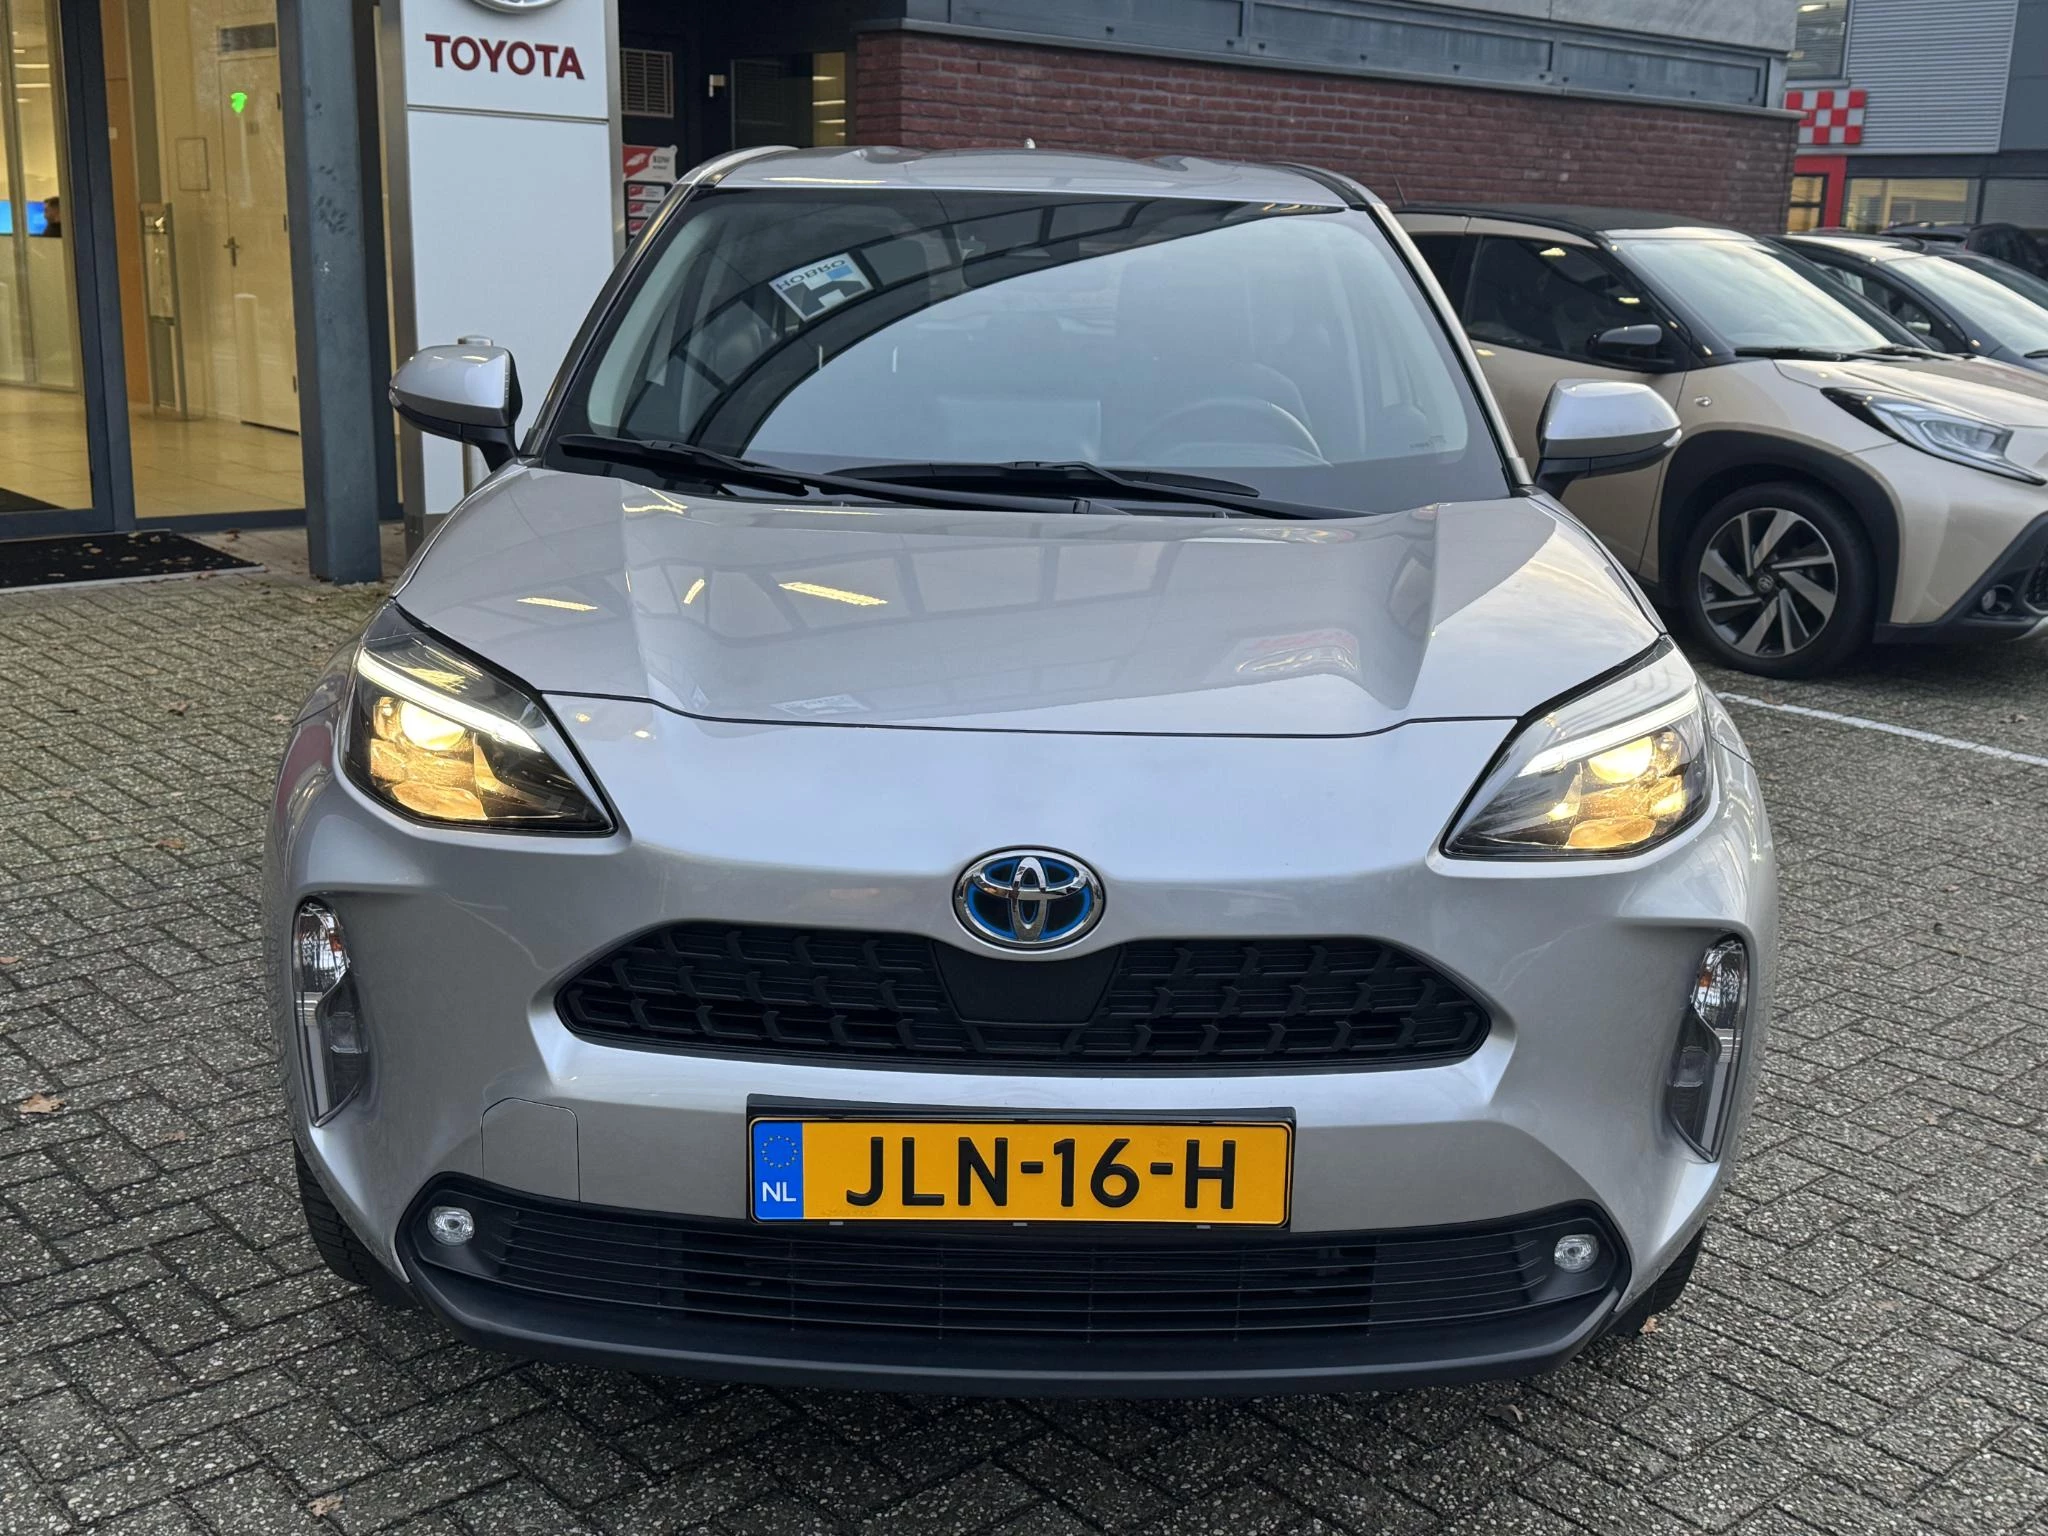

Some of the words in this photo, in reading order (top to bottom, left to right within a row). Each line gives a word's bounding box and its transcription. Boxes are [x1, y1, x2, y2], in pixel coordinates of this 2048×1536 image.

[425, 33, 585, 80] TOYOTA
[762, 1181, 797, 1202] NL
[845, 1136, 1237, 1210] JLN-16-H
